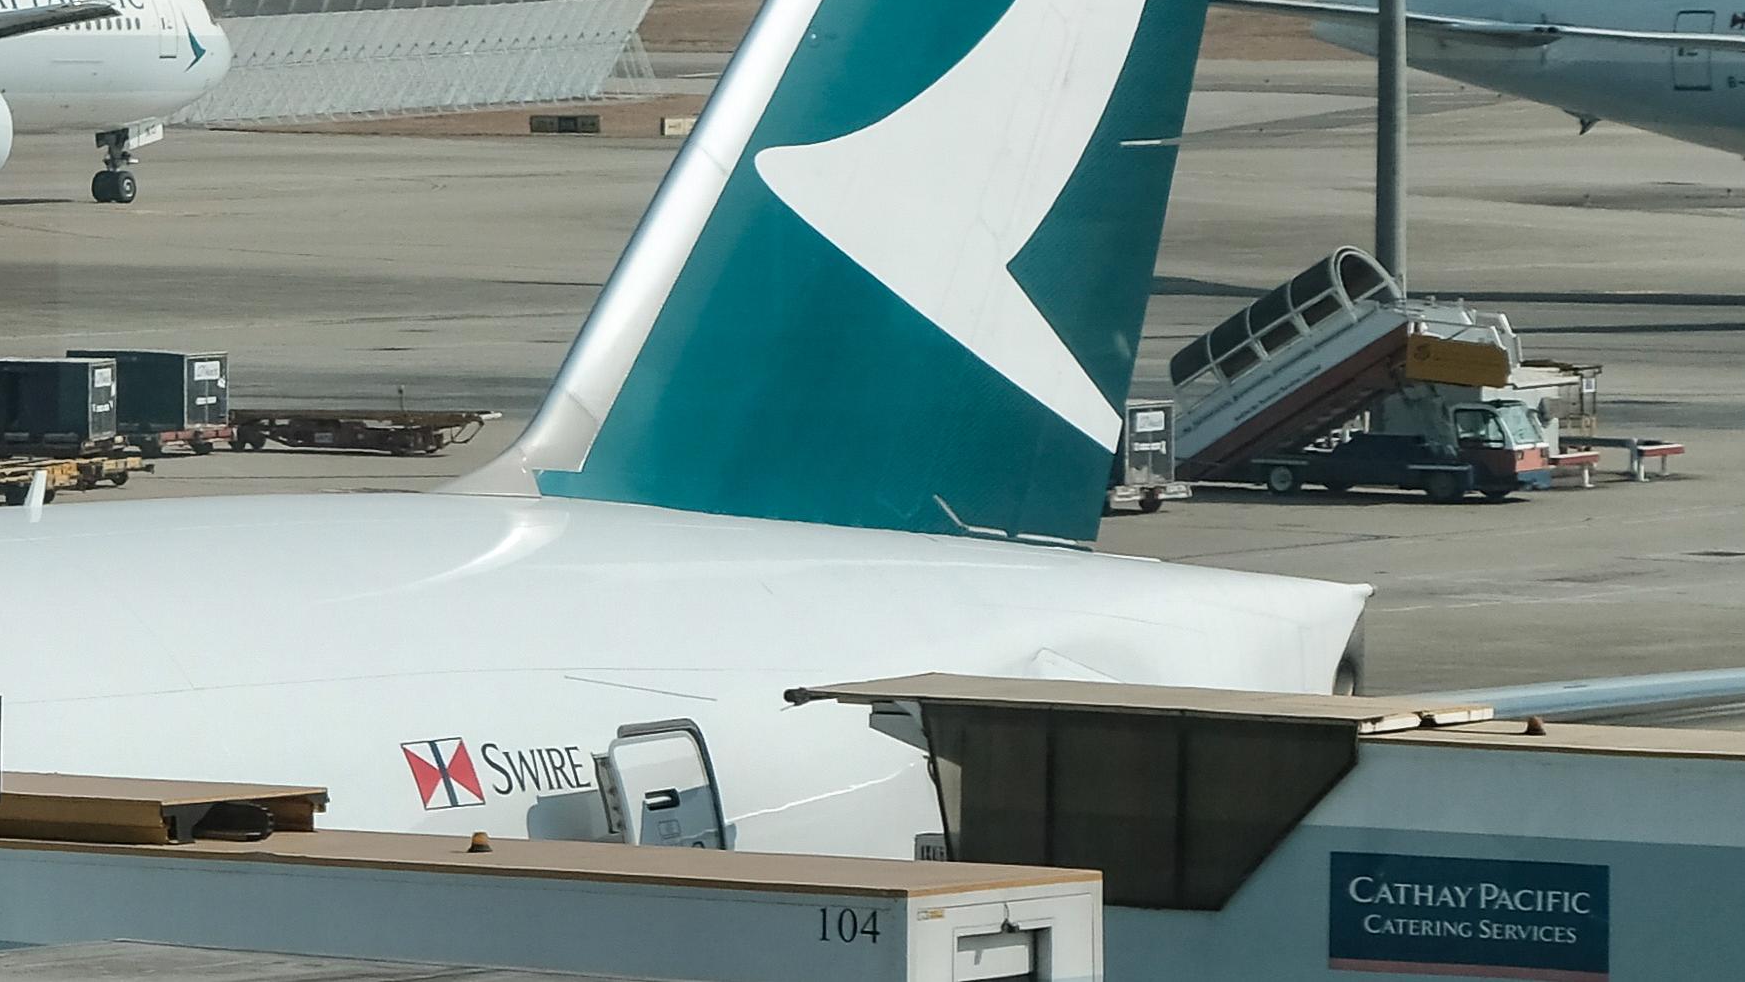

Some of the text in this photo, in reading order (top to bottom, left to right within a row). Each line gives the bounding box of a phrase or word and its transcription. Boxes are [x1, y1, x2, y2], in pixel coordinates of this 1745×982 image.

[481, 743, 592, 795] SWIRE
[1349, 876, 1591, 915] CATHAY PACIFIC
[818, 908, 881, 944] 104
[1364, 914, 1577, 944] CATERING SERVICES
